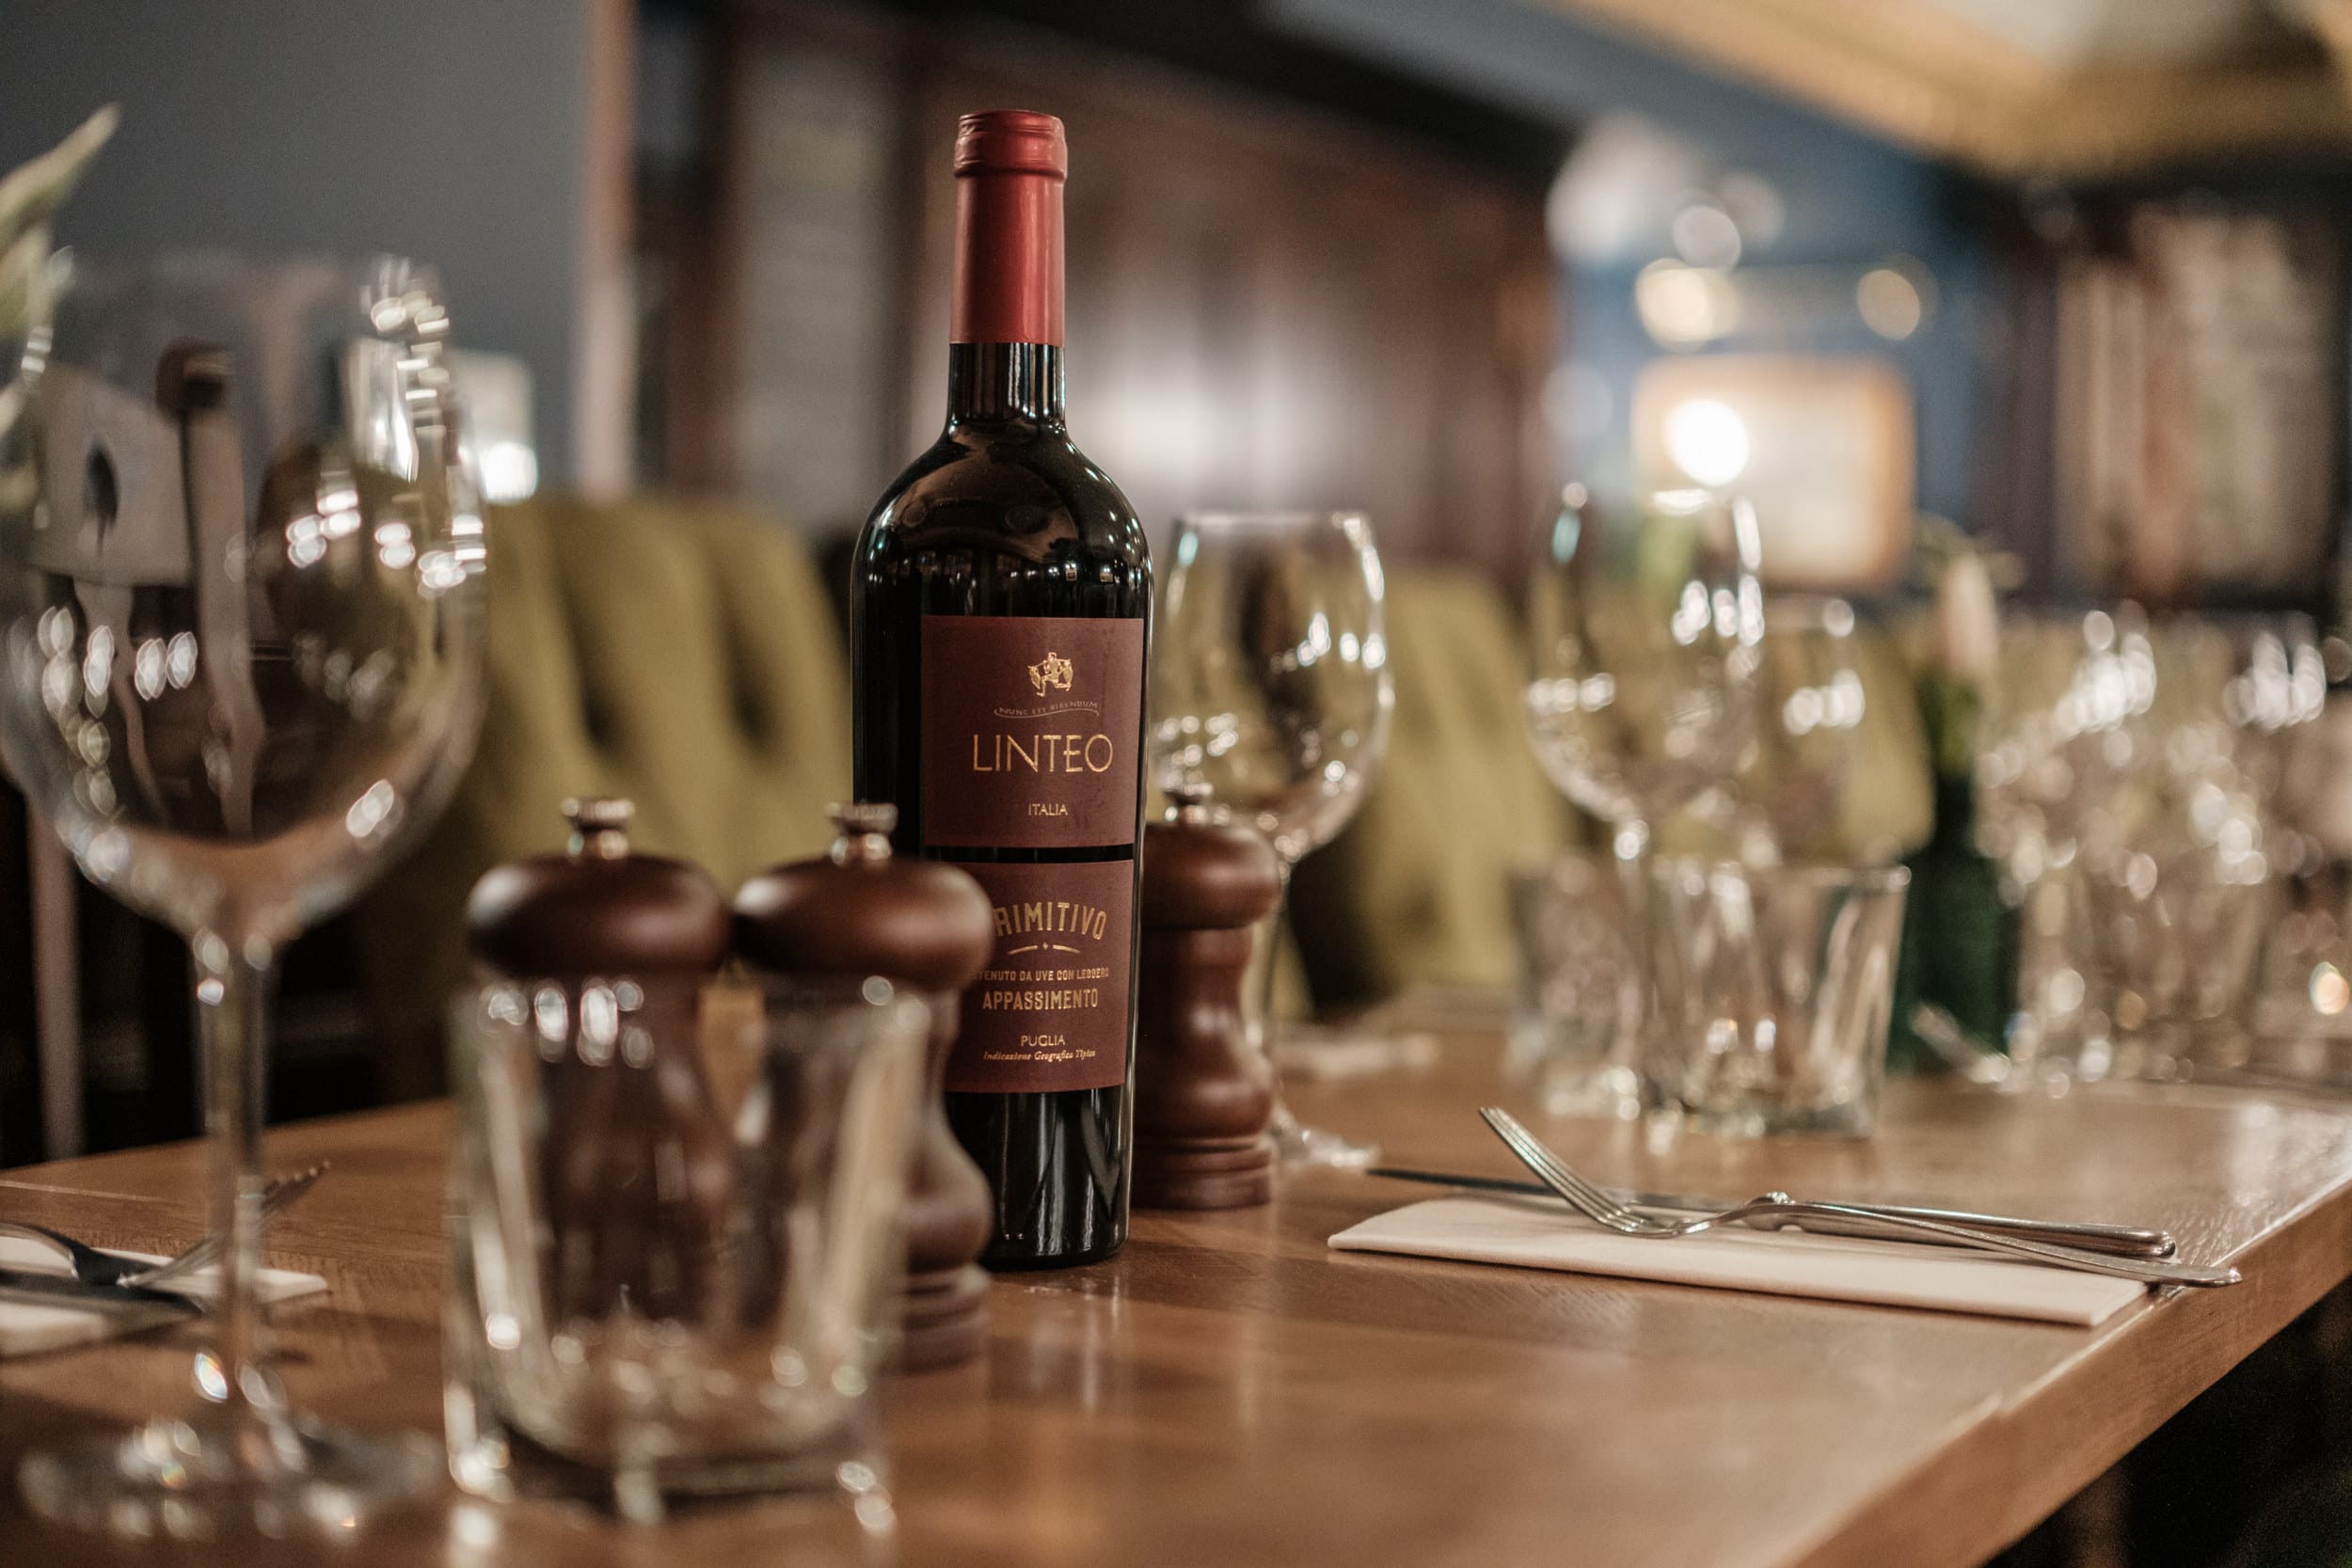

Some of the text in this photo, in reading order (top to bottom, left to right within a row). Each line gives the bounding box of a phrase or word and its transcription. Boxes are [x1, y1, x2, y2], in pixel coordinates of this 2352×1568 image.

[973, 734, 1114, 773] LINTEO
[1027, 802, 1069, 816] ITALIA
[993, 901, 1107, 940] RIMITIVO
[977, 970, 1016, 981] TENUTO
[1019, 970, 1032, 981] DA
[1035, 970, 1055, 981] UVE
[1057, 969, 1074, 980] CON
[982, 988, 1099, 1010] APPASSIMENTO
[1021, 1034, 1066, 1047] PUGLIA
[983, 1051, 1032, 1060] Indicazione
[1034, 1050, 1073, 1063] Geografica
